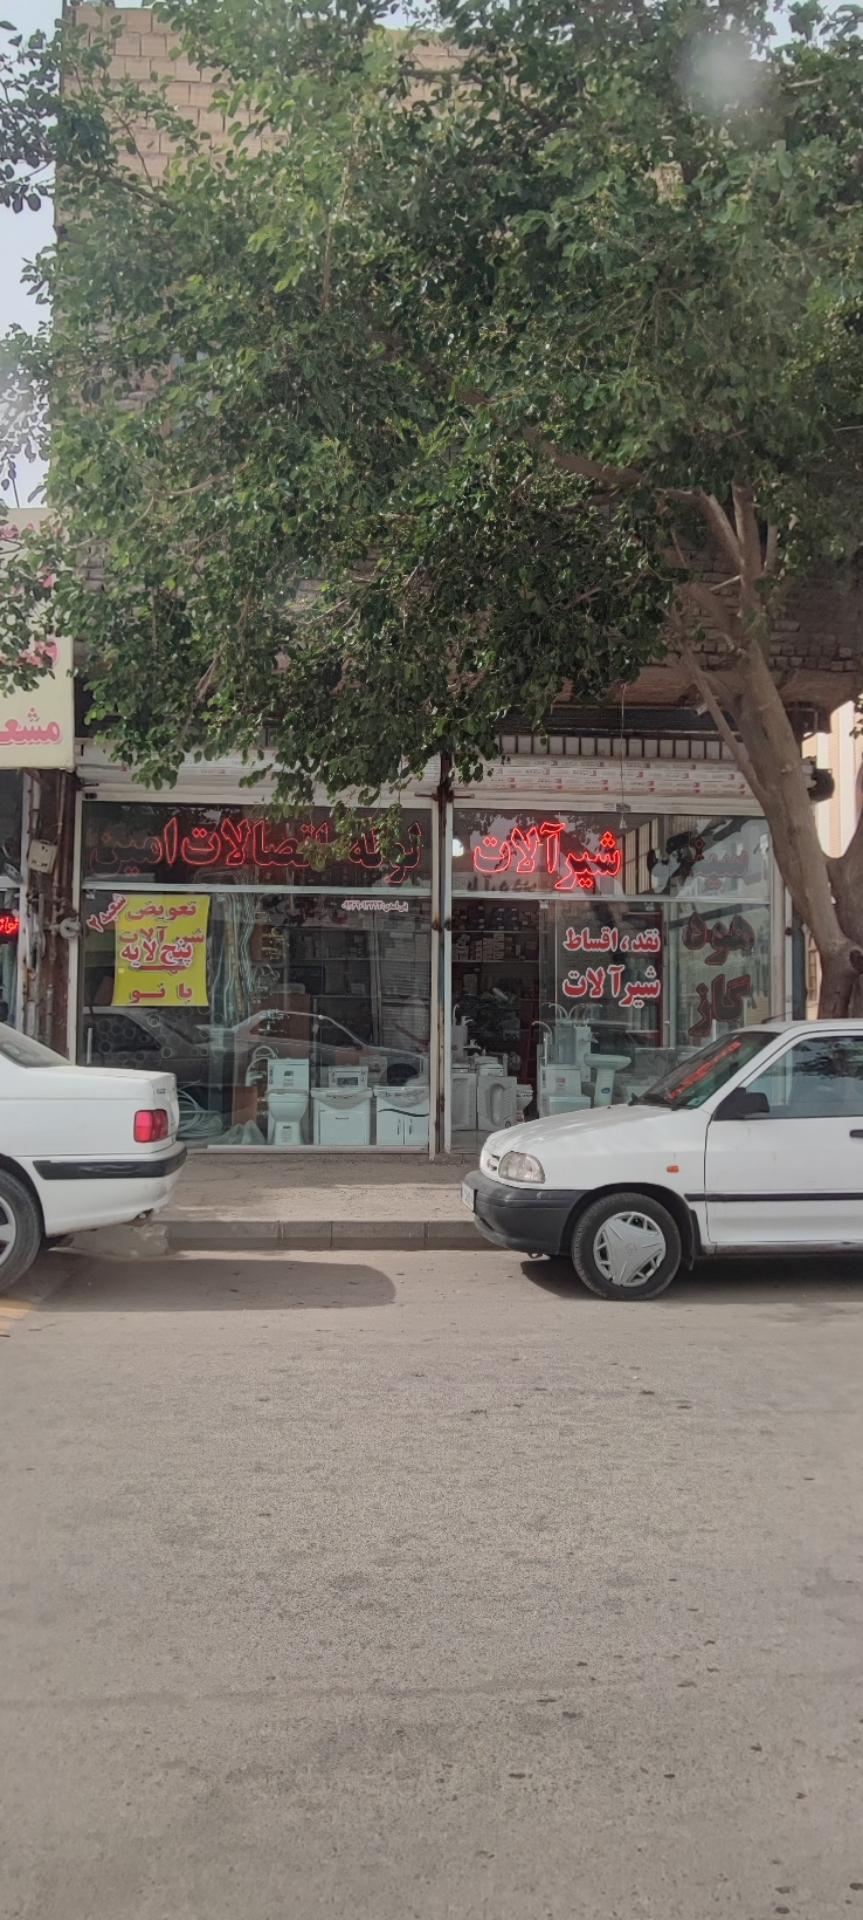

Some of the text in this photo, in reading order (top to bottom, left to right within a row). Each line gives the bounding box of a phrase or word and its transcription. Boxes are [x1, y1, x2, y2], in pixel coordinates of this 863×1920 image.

[0, 706, 62, 746] مشع
[127, 901, 198, 921] تعویض
[562, 926, 619, 953] اقساط
[119, 939, 194, 969] پنج لایه
[177, 983, 193, 1004] با
[688, 973, 753, 1038] گاز
